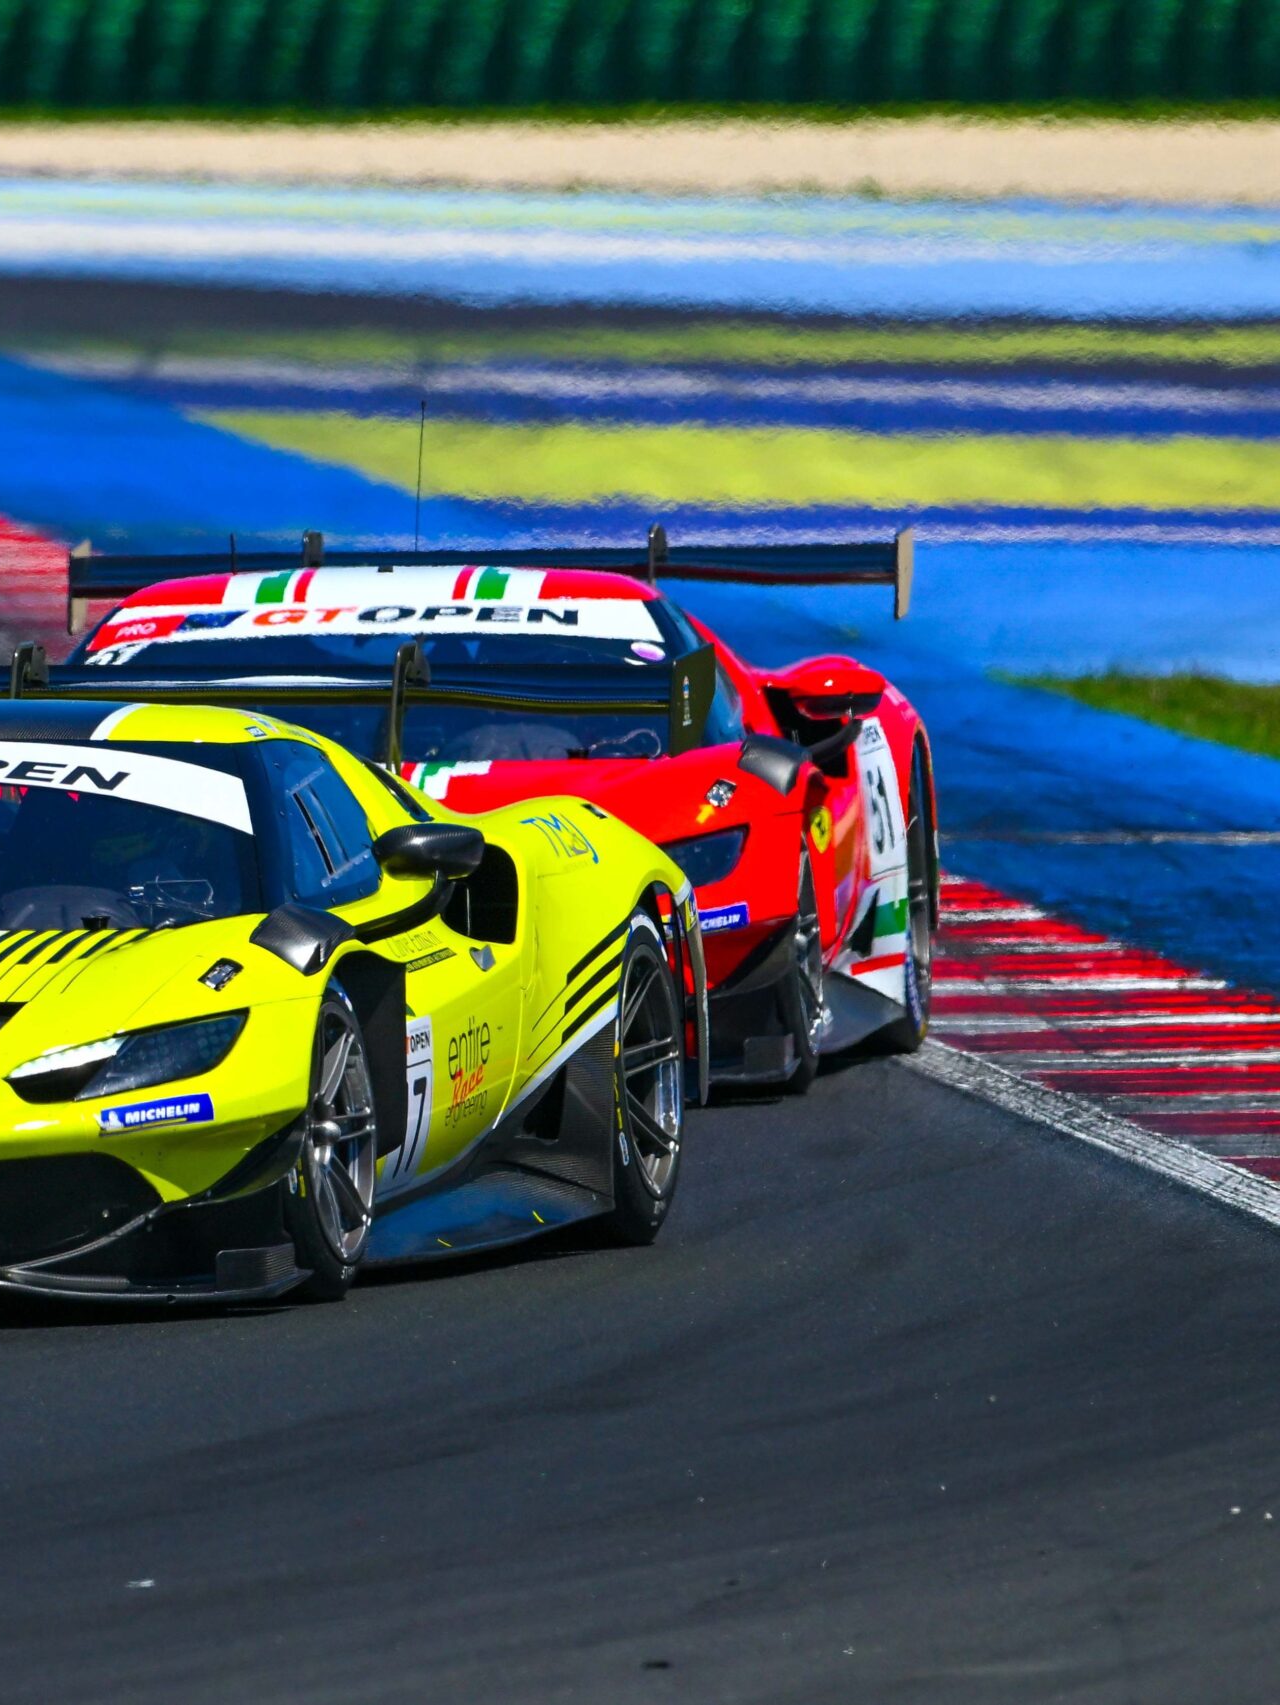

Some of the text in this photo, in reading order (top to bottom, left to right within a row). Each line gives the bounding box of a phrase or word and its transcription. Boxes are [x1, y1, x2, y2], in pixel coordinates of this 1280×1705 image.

[115, 622, 157, 639] PRO
[866, 765, 895, 856] 51
[700, 913, 741, 931] CHELIN
[447, 1015, 491, 1081] entire
[452, 1063, 485, 1108] Race
[124, 1102, 201, 1125] MICHELIN
